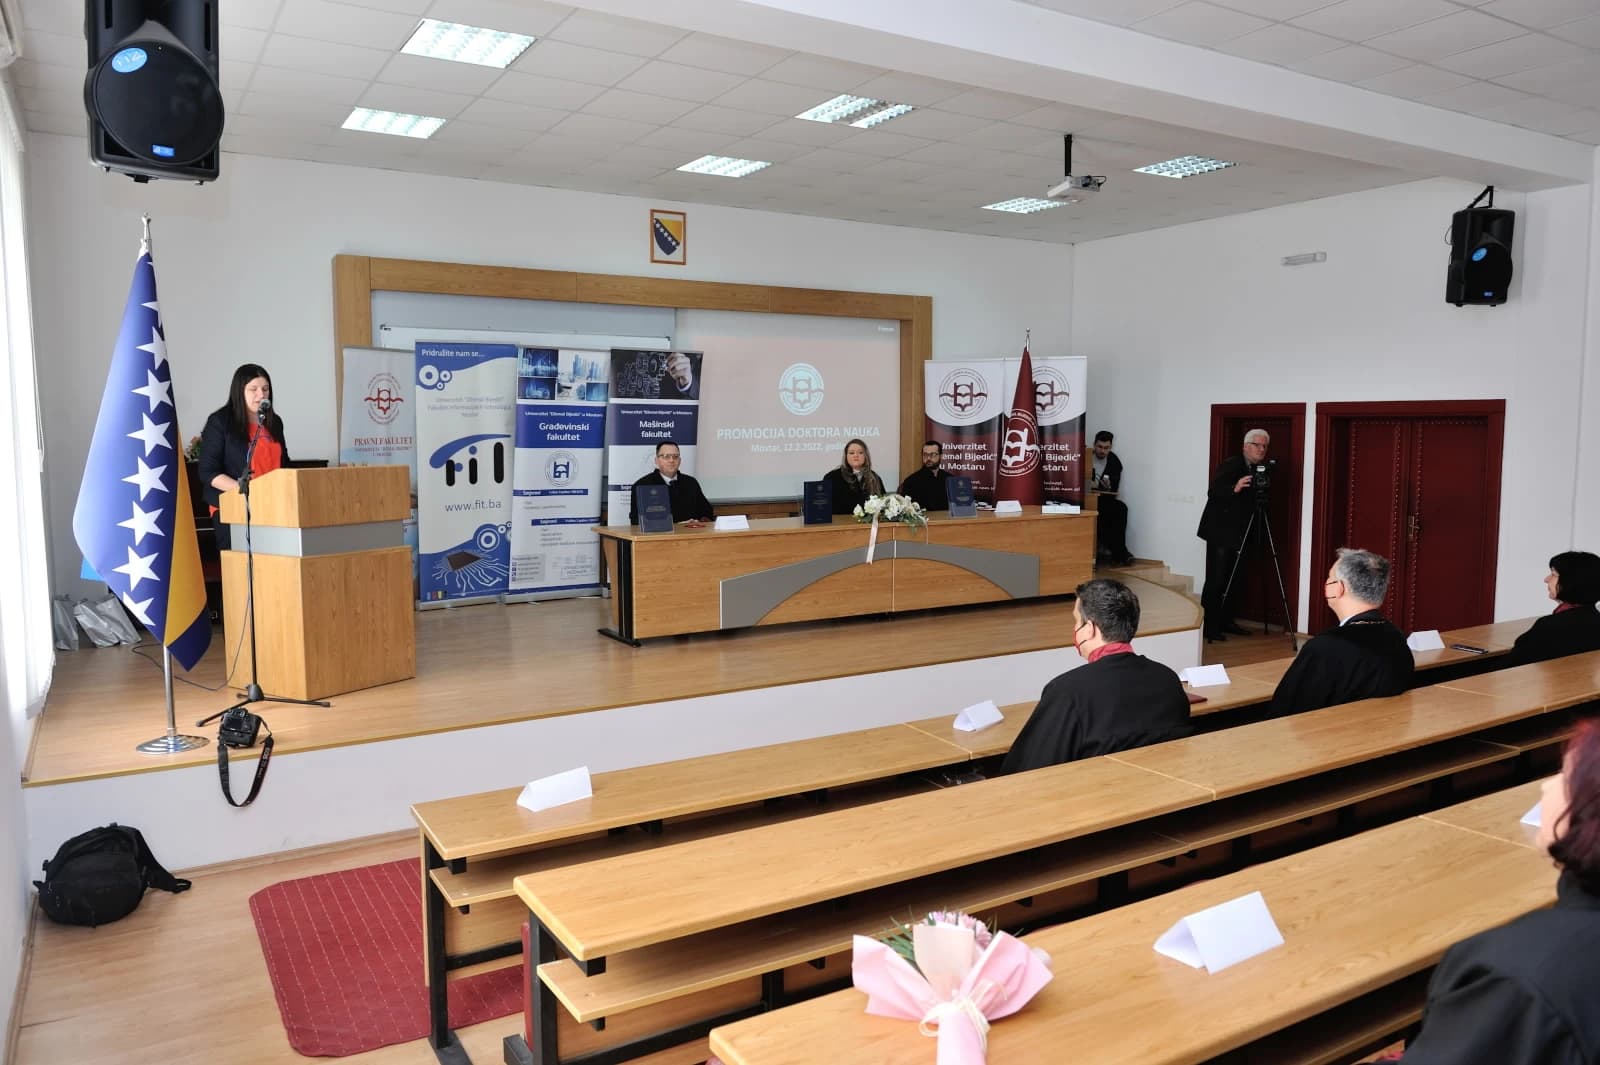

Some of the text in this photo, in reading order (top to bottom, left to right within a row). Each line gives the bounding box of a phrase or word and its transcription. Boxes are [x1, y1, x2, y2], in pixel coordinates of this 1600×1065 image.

[546, 432, 581, 441] fakultet
[641, 430, 673, 438] fakultet
[716, 425, 881, 441] PROMOCIJA DOKTORA NAUKA
[947, 462, 986, 471] Mostaru
[445, 499, 502, 512] www.fit.ba
